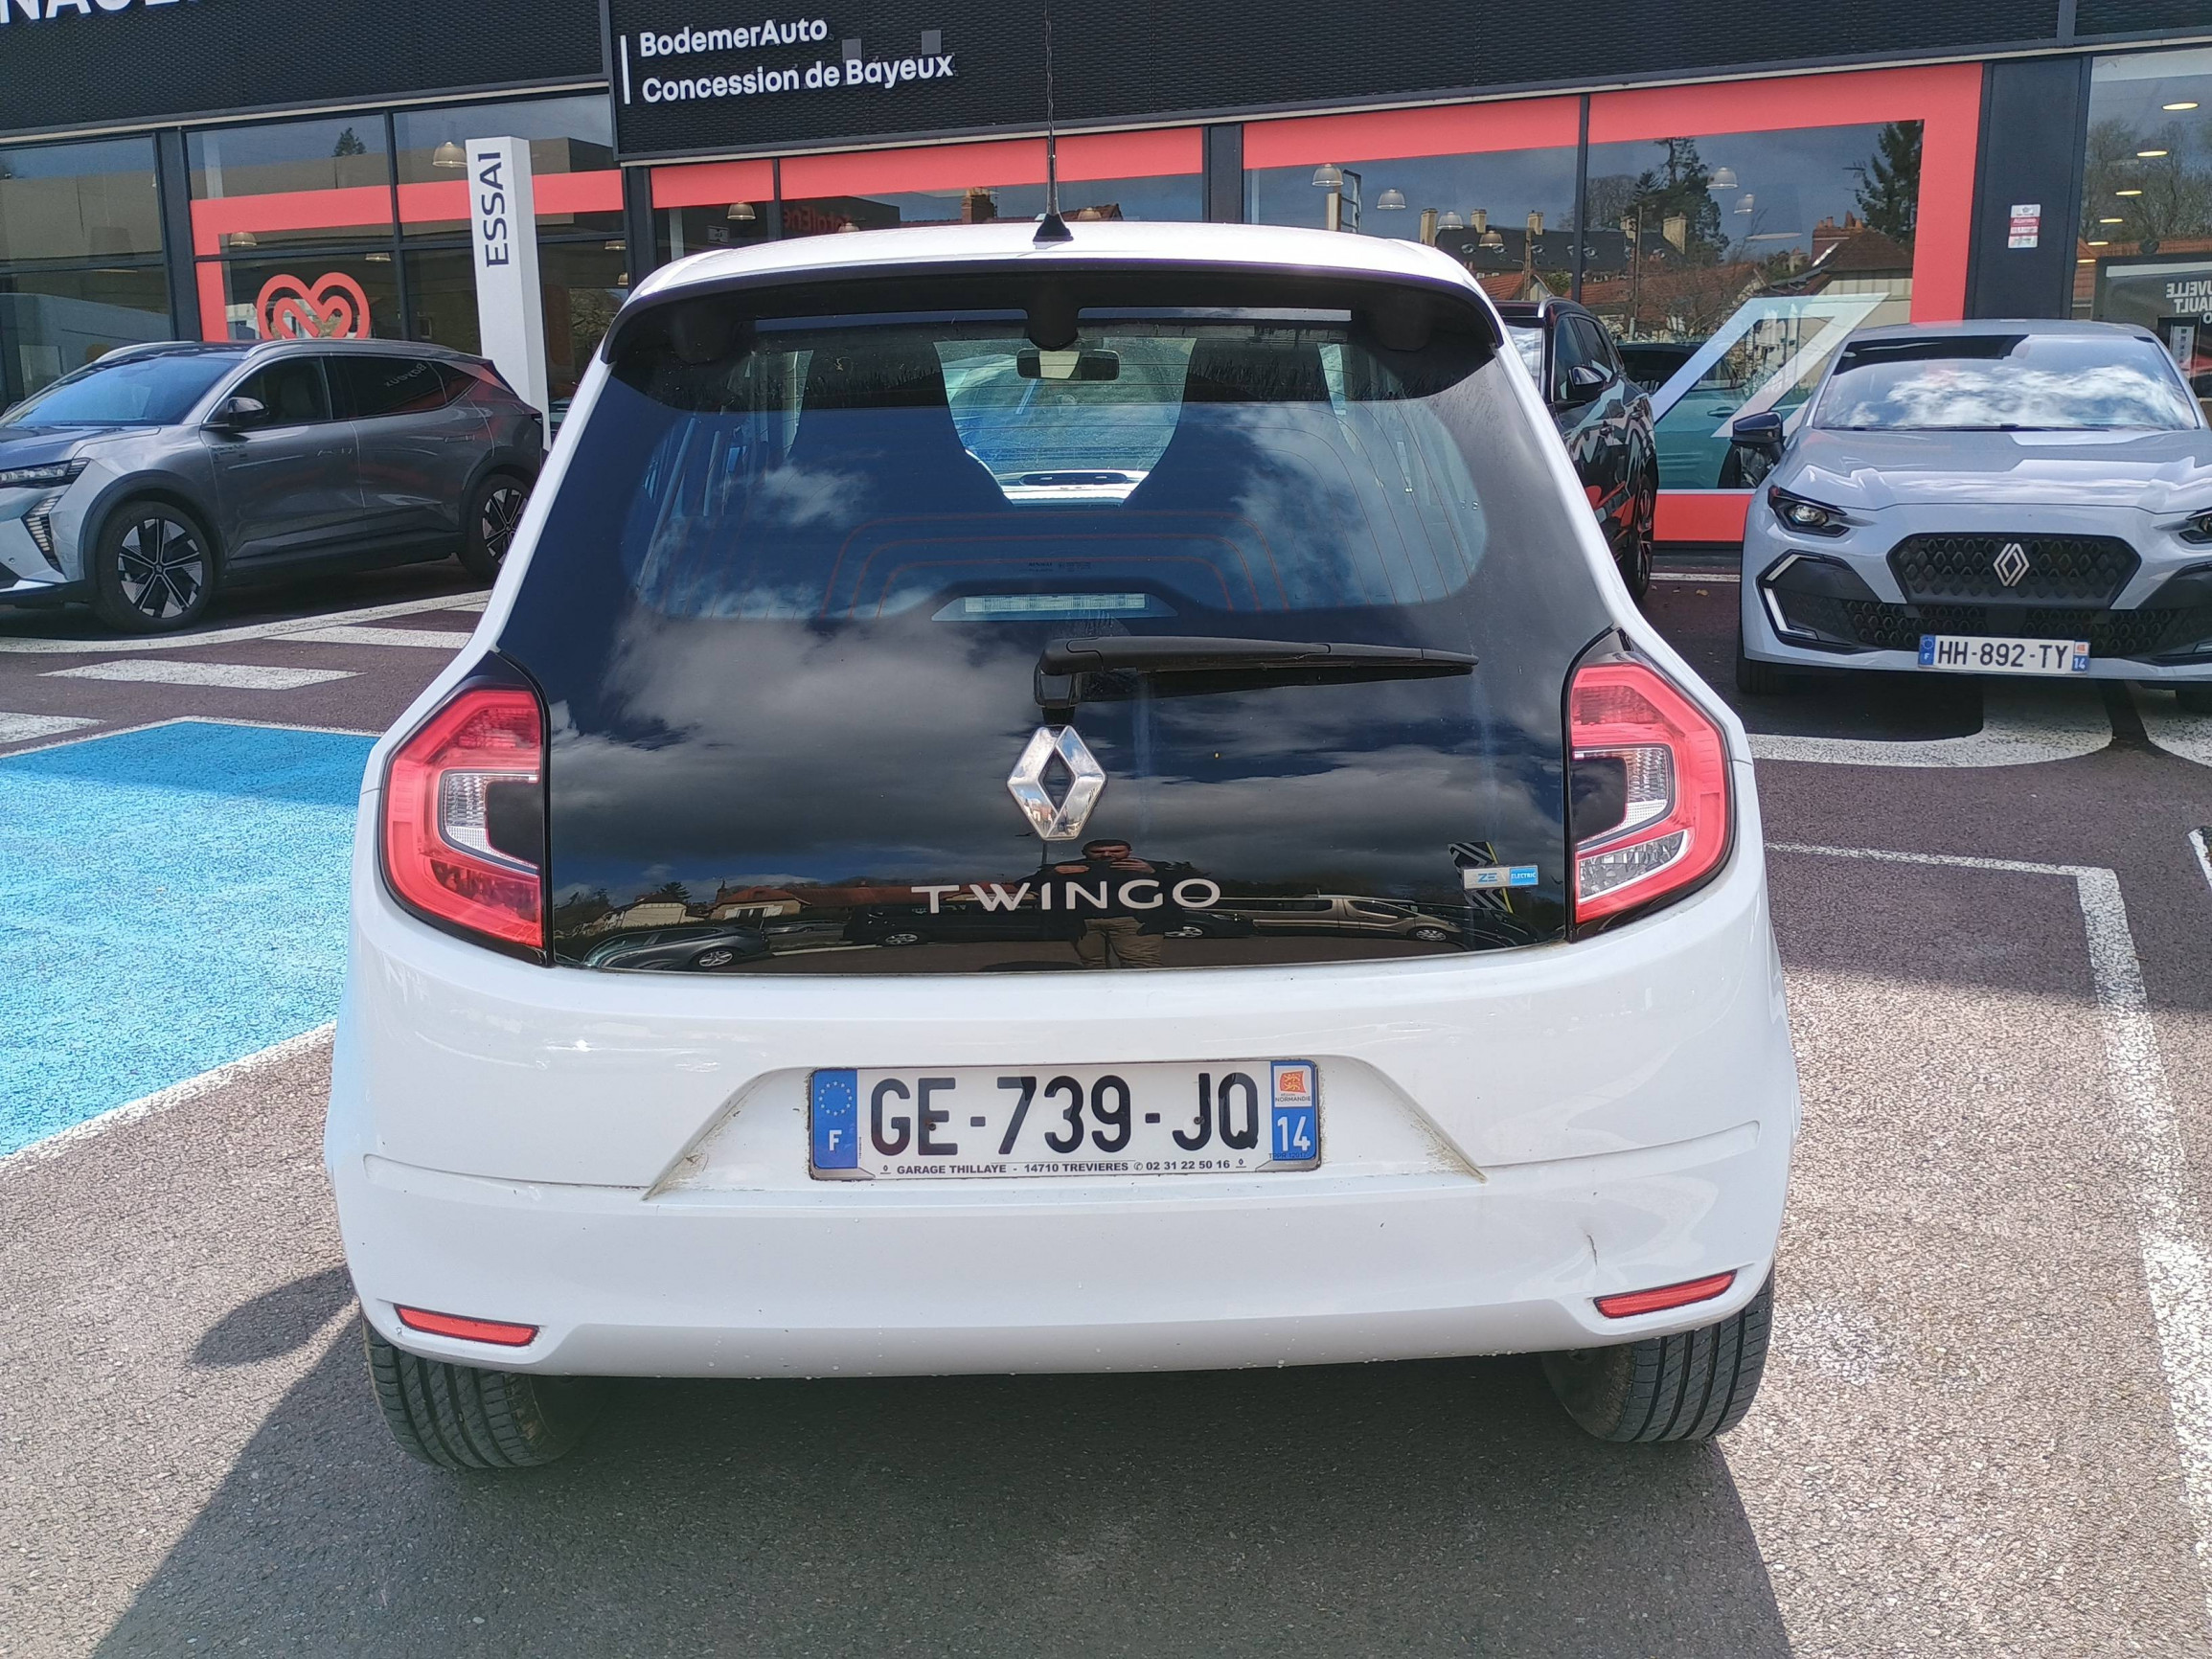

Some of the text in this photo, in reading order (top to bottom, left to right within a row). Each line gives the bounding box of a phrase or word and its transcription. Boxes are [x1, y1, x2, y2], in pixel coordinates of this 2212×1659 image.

[640, 18, 828, 57] BodemerAuto
[642, 55, 954, 103] Concession de Bayeux
[477, 152, 510, 267] ESSAI
[1937, 641, 2069, 669] HH-892-TY
[2073, 657, 2086, 670] 14
[911, 878, 1221, 914] TWINGO
[870, 1072, 1259, 1156] GE-739-JQ
[829, 1129, 842, 1151] F
[1277, 1116, 1311, 1152] 14
[897, 1165, 946, 1174] GARAGE
[949, 1164, 1007, 1174] THILLAYE
[1024, 1164, 1060, 1173] 14710
[1061, 1162, 1129, 1172] TREVIERES
[1146, 1161, 1160, 1170] 02
[1164, 1161, 1177, 1170] 31
[1181, 1160, 1196, 1170] 22
[1198, 1160, 1213, 1169] 50
[1216, 1159, 1230, 1169] 16
